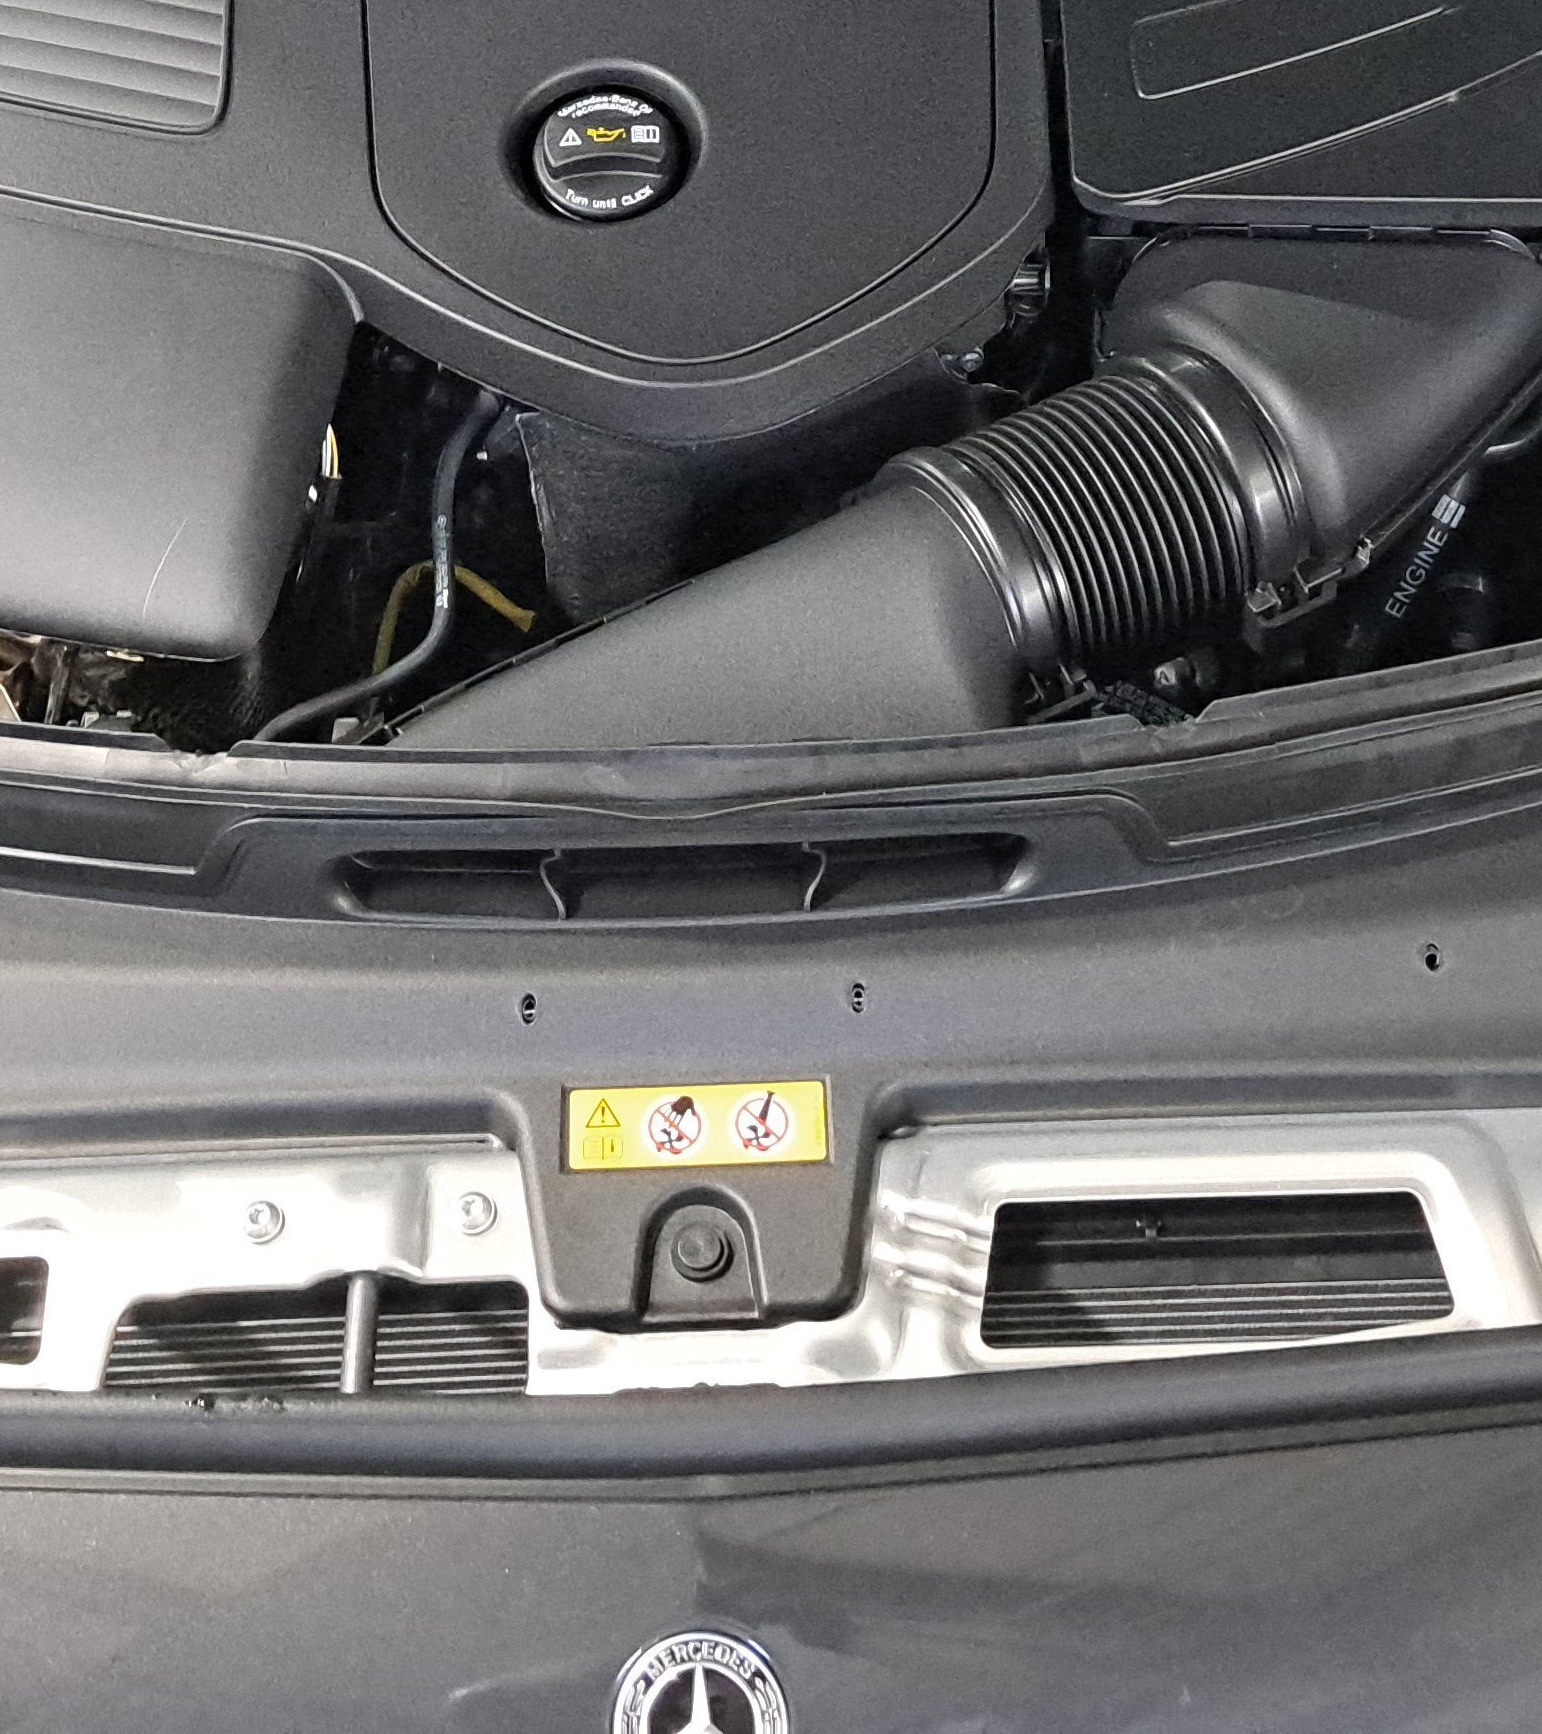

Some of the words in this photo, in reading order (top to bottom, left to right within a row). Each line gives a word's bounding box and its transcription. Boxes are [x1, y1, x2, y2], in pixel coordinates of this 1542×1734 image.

[565, 188, 589, 206] Turn
[592, 197, 617, 209] until
[621, 184, 654, 207] CLICK
[1385, 526, 1449, 619] ENGINE
